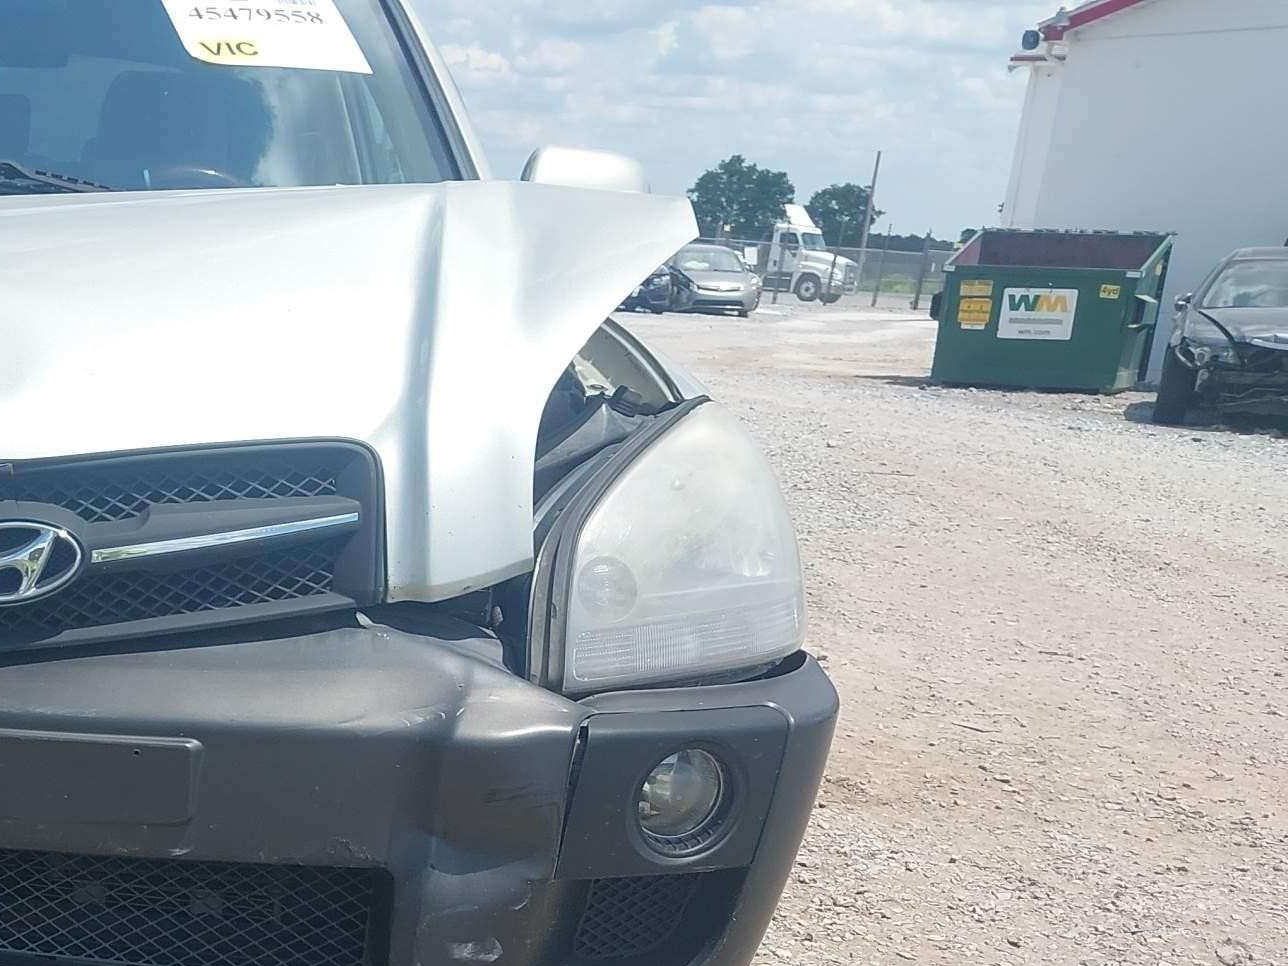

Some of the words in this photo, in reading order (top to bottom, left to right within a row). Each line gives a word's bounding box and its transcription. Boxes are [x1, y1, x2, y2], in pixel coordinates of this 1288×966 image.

[188, 6, 324, 24] 45479558
[199, 42, 259, 56] VIC
[1008, 294, 1068, 312] WM
